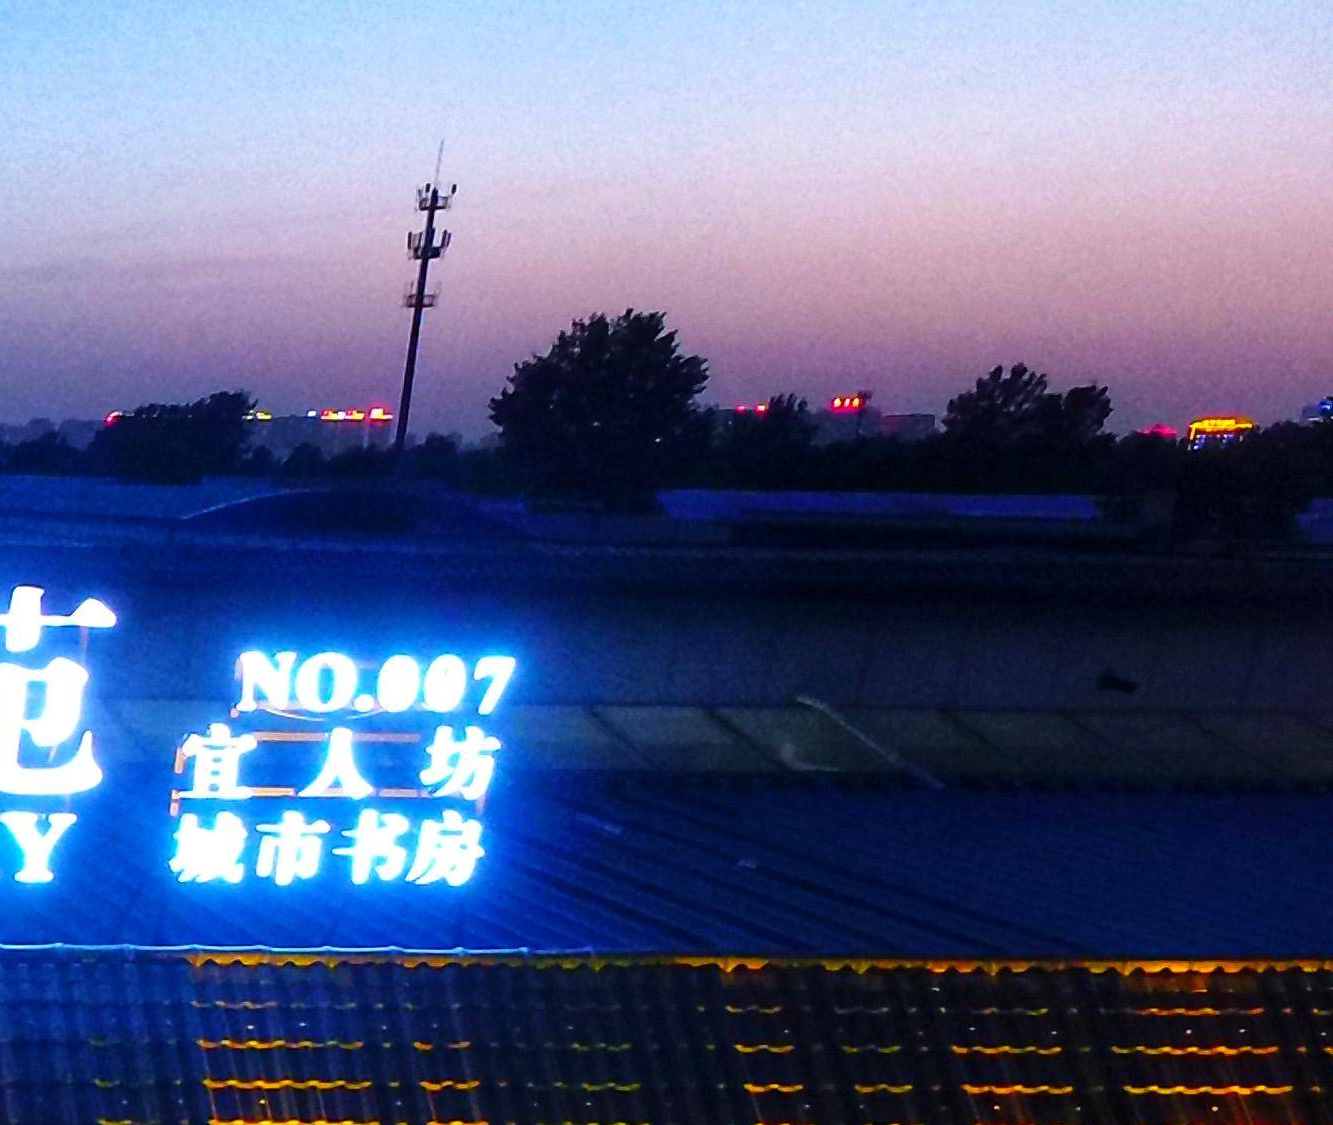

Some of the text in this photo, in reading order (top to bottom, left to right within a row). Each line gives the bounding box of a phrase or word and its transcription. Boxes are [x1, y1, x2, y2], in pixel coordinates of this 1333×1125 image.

[236, 651, 516, 714] NO.007
[179, 723, 501, 800] 宜人坊
[169, 809, 485, 886] 城市书房
